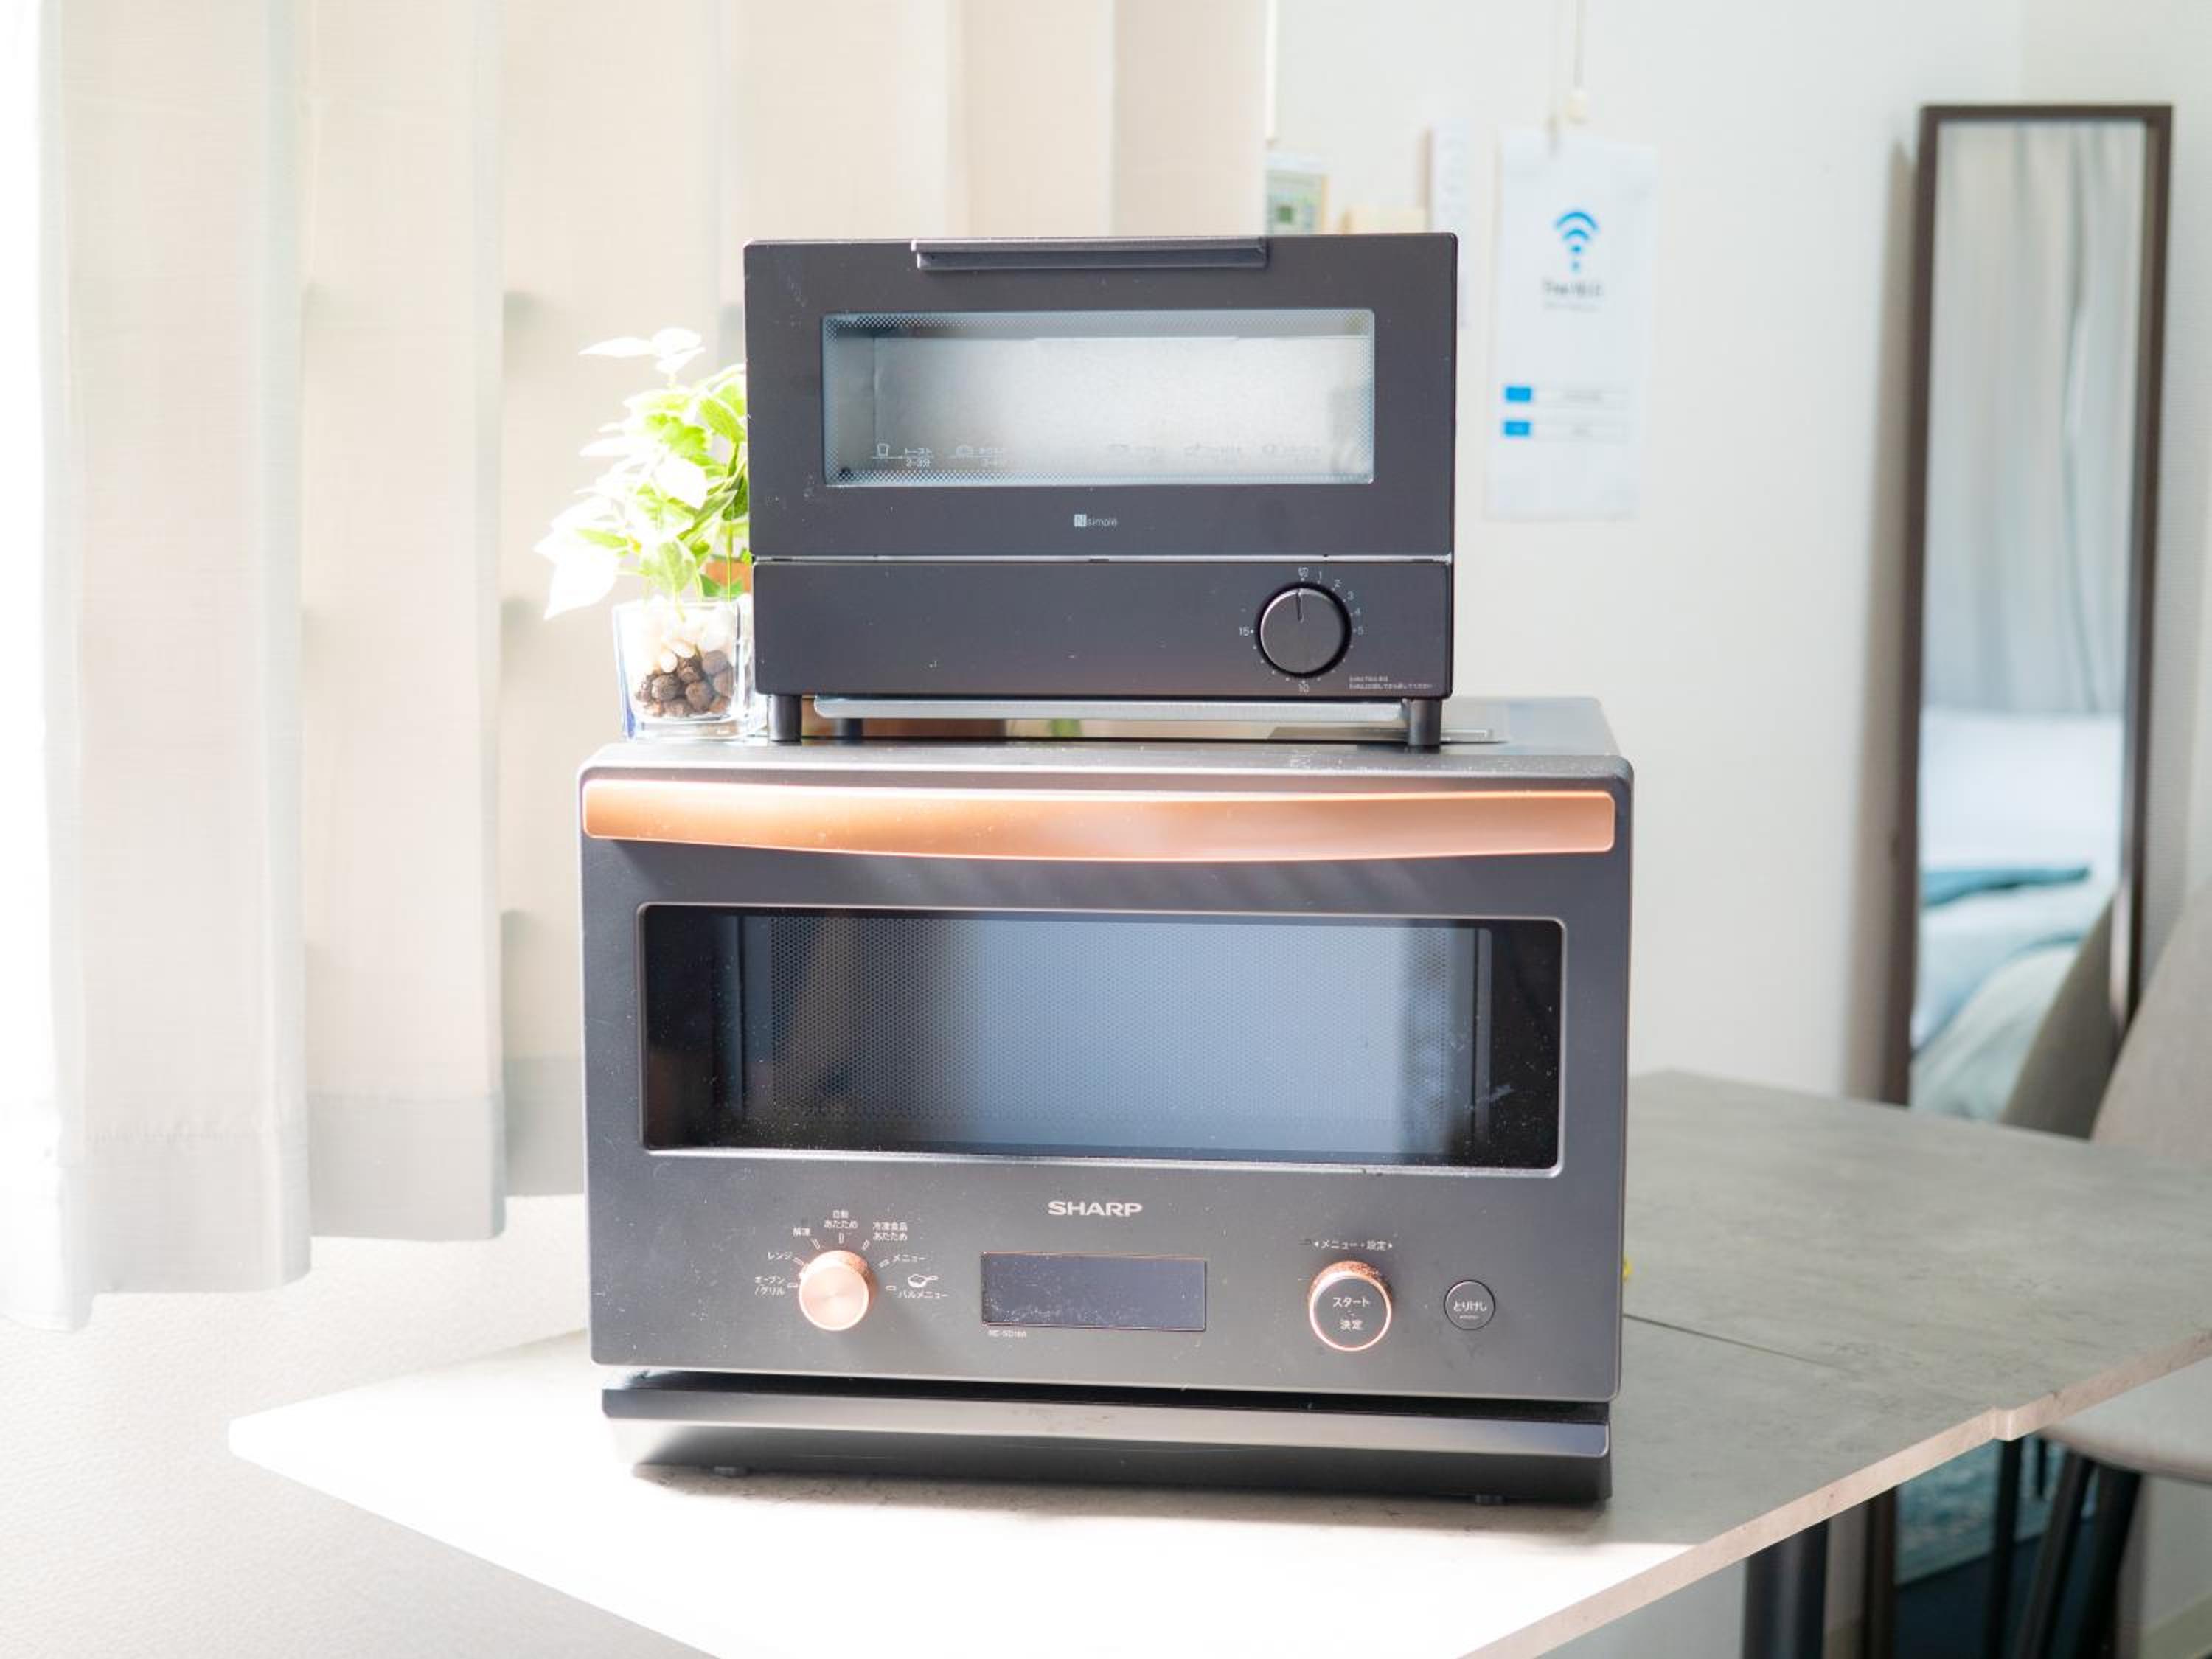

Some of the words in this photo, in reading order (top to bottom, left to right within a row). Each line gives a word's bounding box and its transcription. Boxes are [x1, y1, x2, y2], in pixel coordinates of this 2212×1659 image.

[1333, 579, 1342, 588] 2
[1347, 591, 1354, 600] 3
[1355, 607, 1362, 616] 4
[1239, 627, 1250, 636] 15
[1357, 626, 1364, 636] 5
[1298, 684, 1310, 693] 10
[1048, 1200, 1144, 1217] SHARP
[824, 1220, 858, 1229] あたため
[873, 1231, 908, 1242] あたため
[768, 1251, 793, 1260] レンジ
[893, 1254, 926, 1264] メニュー
[1332, 1296, 1371, 1308] スタート
[1453, 1300, 1488, 1312] とりけし
[1340, 1319, 1363, 1331] 決定
